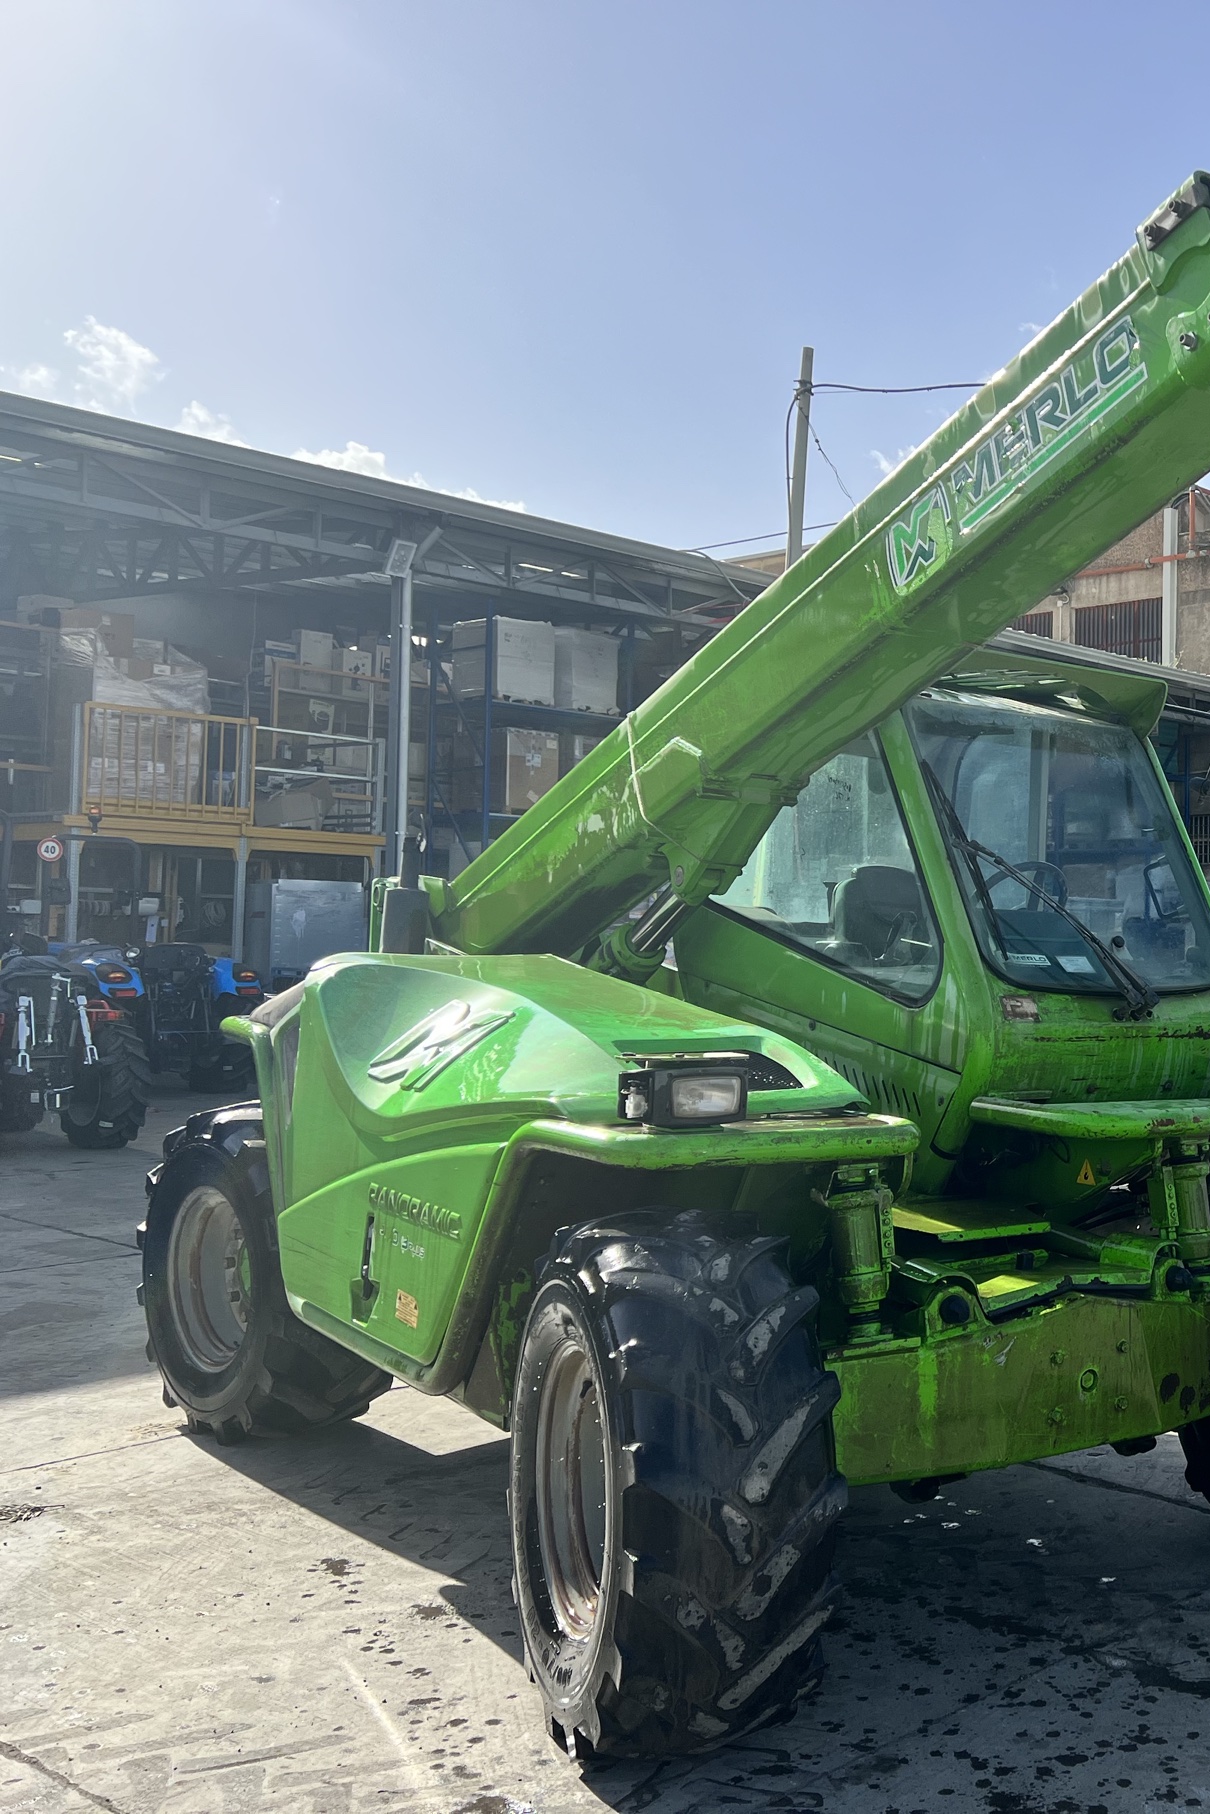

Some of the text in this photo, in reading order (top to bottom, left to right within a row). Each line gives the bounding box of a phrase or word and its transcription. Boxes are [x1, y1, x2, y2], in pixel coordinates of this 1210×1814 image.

[950, 315, 1140, 501] MERLO
[43, 845, 56, 855] 40
[368, 1181, 462, 1240] PANORAMIC
